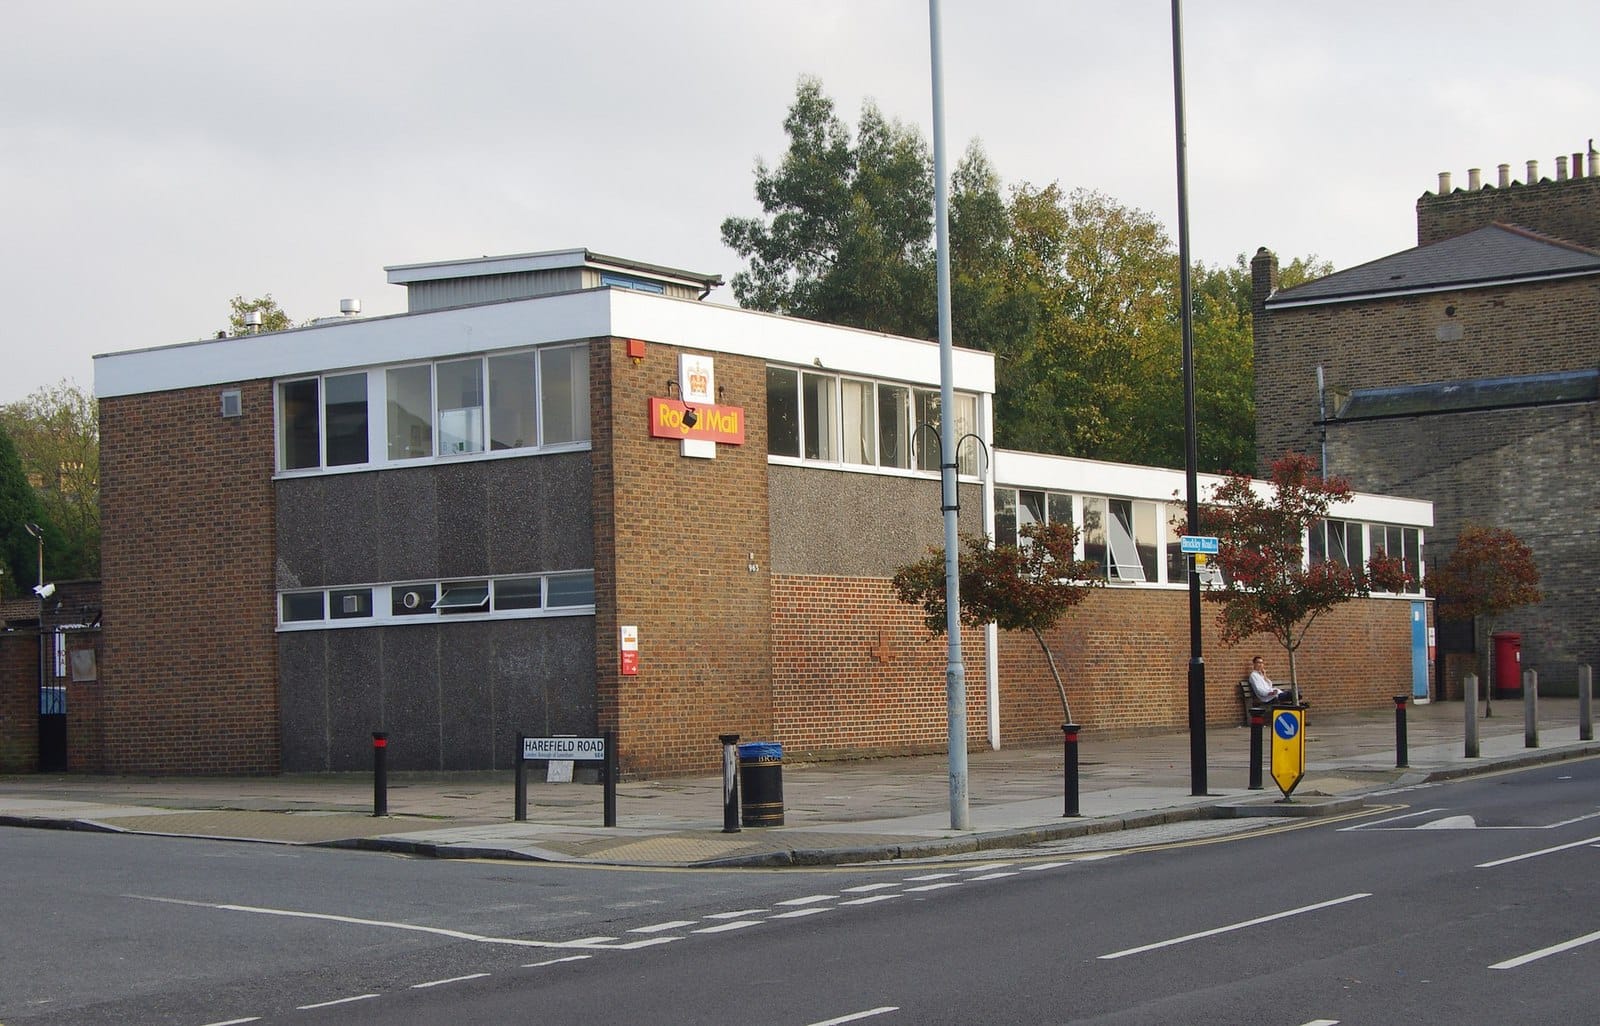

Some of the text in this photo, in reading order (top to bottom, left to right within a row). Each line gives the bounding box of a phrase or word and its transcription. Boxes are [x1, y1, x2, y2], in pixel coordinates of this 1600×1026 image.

[706, 408, 738, 434] Mail
[525, 740, 604, 752] HAREFIELD ROAD
